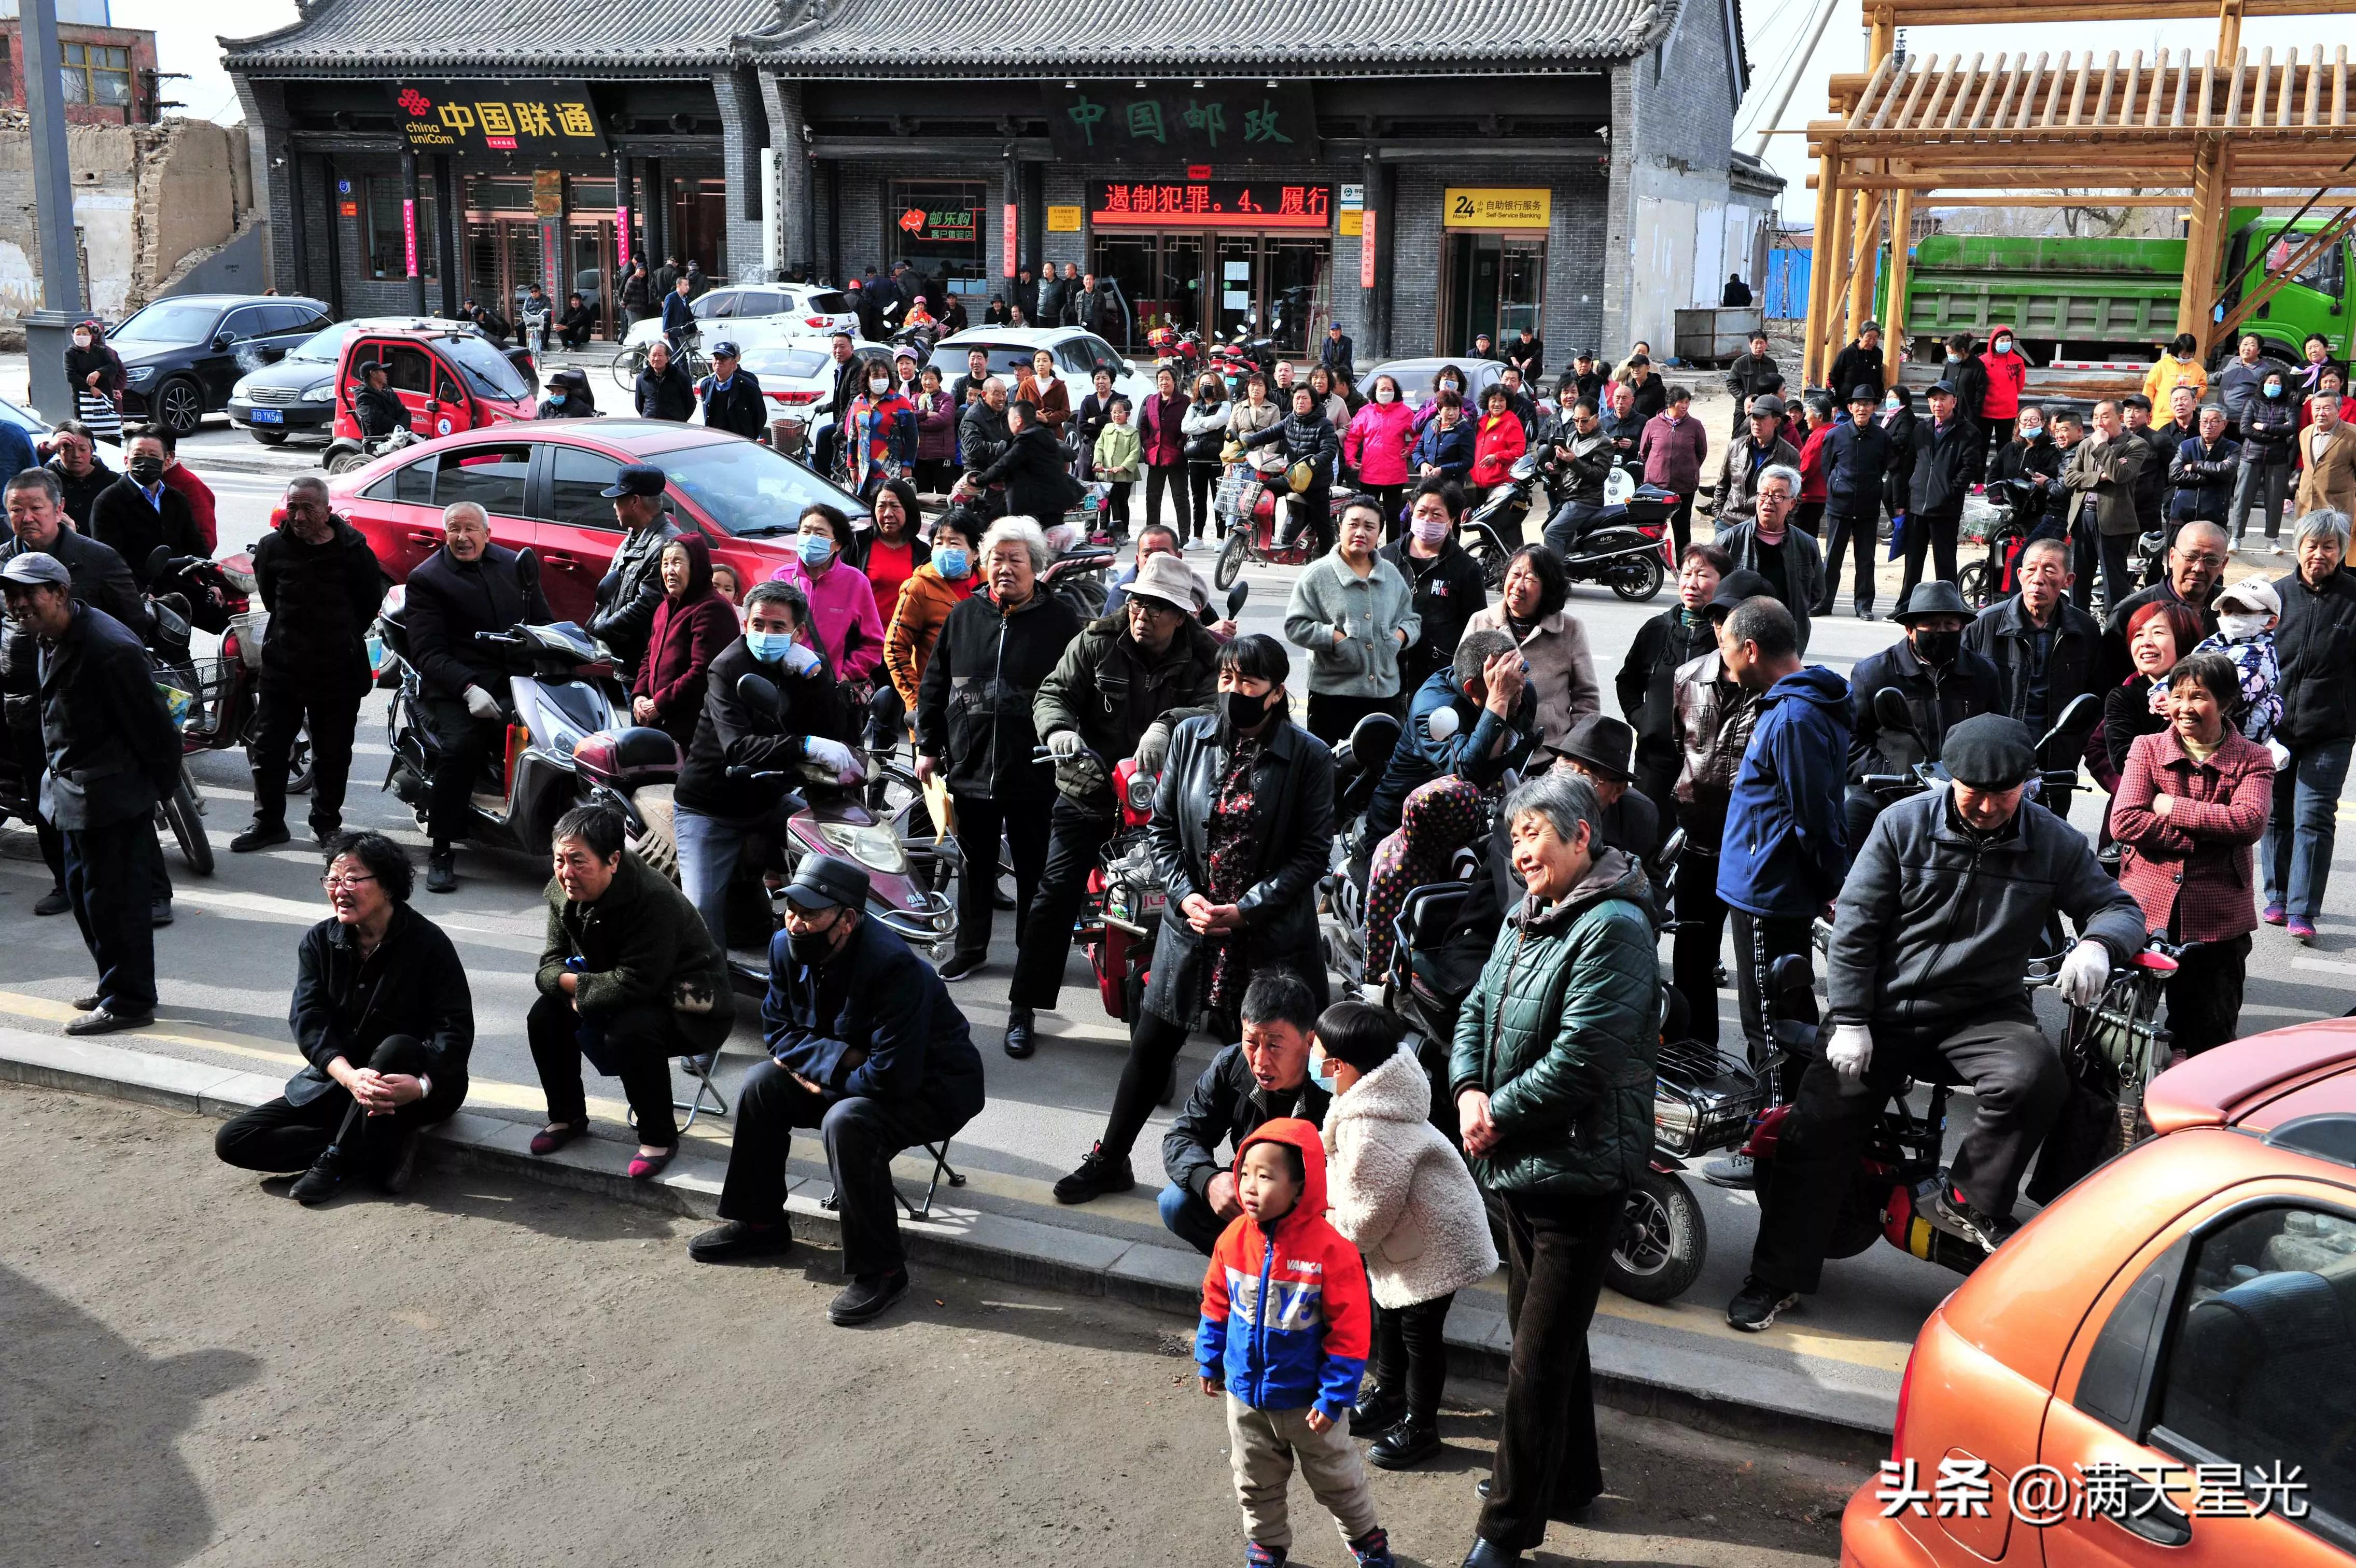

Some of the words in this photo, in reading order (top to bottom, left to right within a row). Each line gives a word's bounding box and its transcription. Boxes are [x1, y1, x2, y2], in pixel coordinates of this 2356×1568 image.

[438, 102, 596, 137] 中国联通
[1068, 95, 1294, 147] 中国邮政
[406, 122, 440, 133] china
[1454, 195, 1476, 218] 24
[1486, 200, 1541, 211] 自助银行服务
[928, 212, 971, 226] 邮乐购
[931, 230, 973, 239] 客户体验店
[1432, 579, 1445, 588] MY
